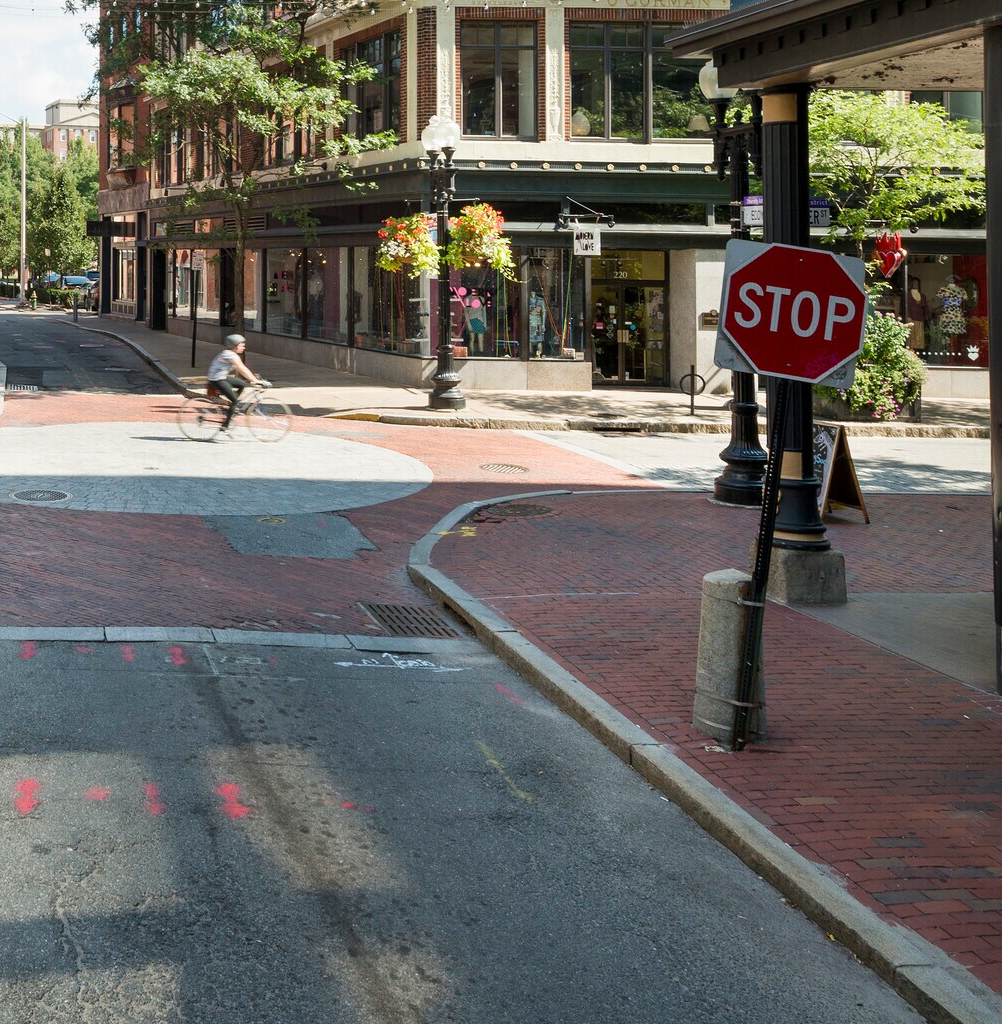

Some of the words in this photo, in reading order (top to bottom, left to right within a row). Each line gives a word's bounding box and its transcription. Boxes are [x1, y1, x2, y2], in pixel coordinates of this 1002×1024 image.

[751, 210, 764, 221] EDD
[820, 209, 828, 218] ST
[614, 271, 628, 279] 220
[734, 282, 856, 341] STOP
